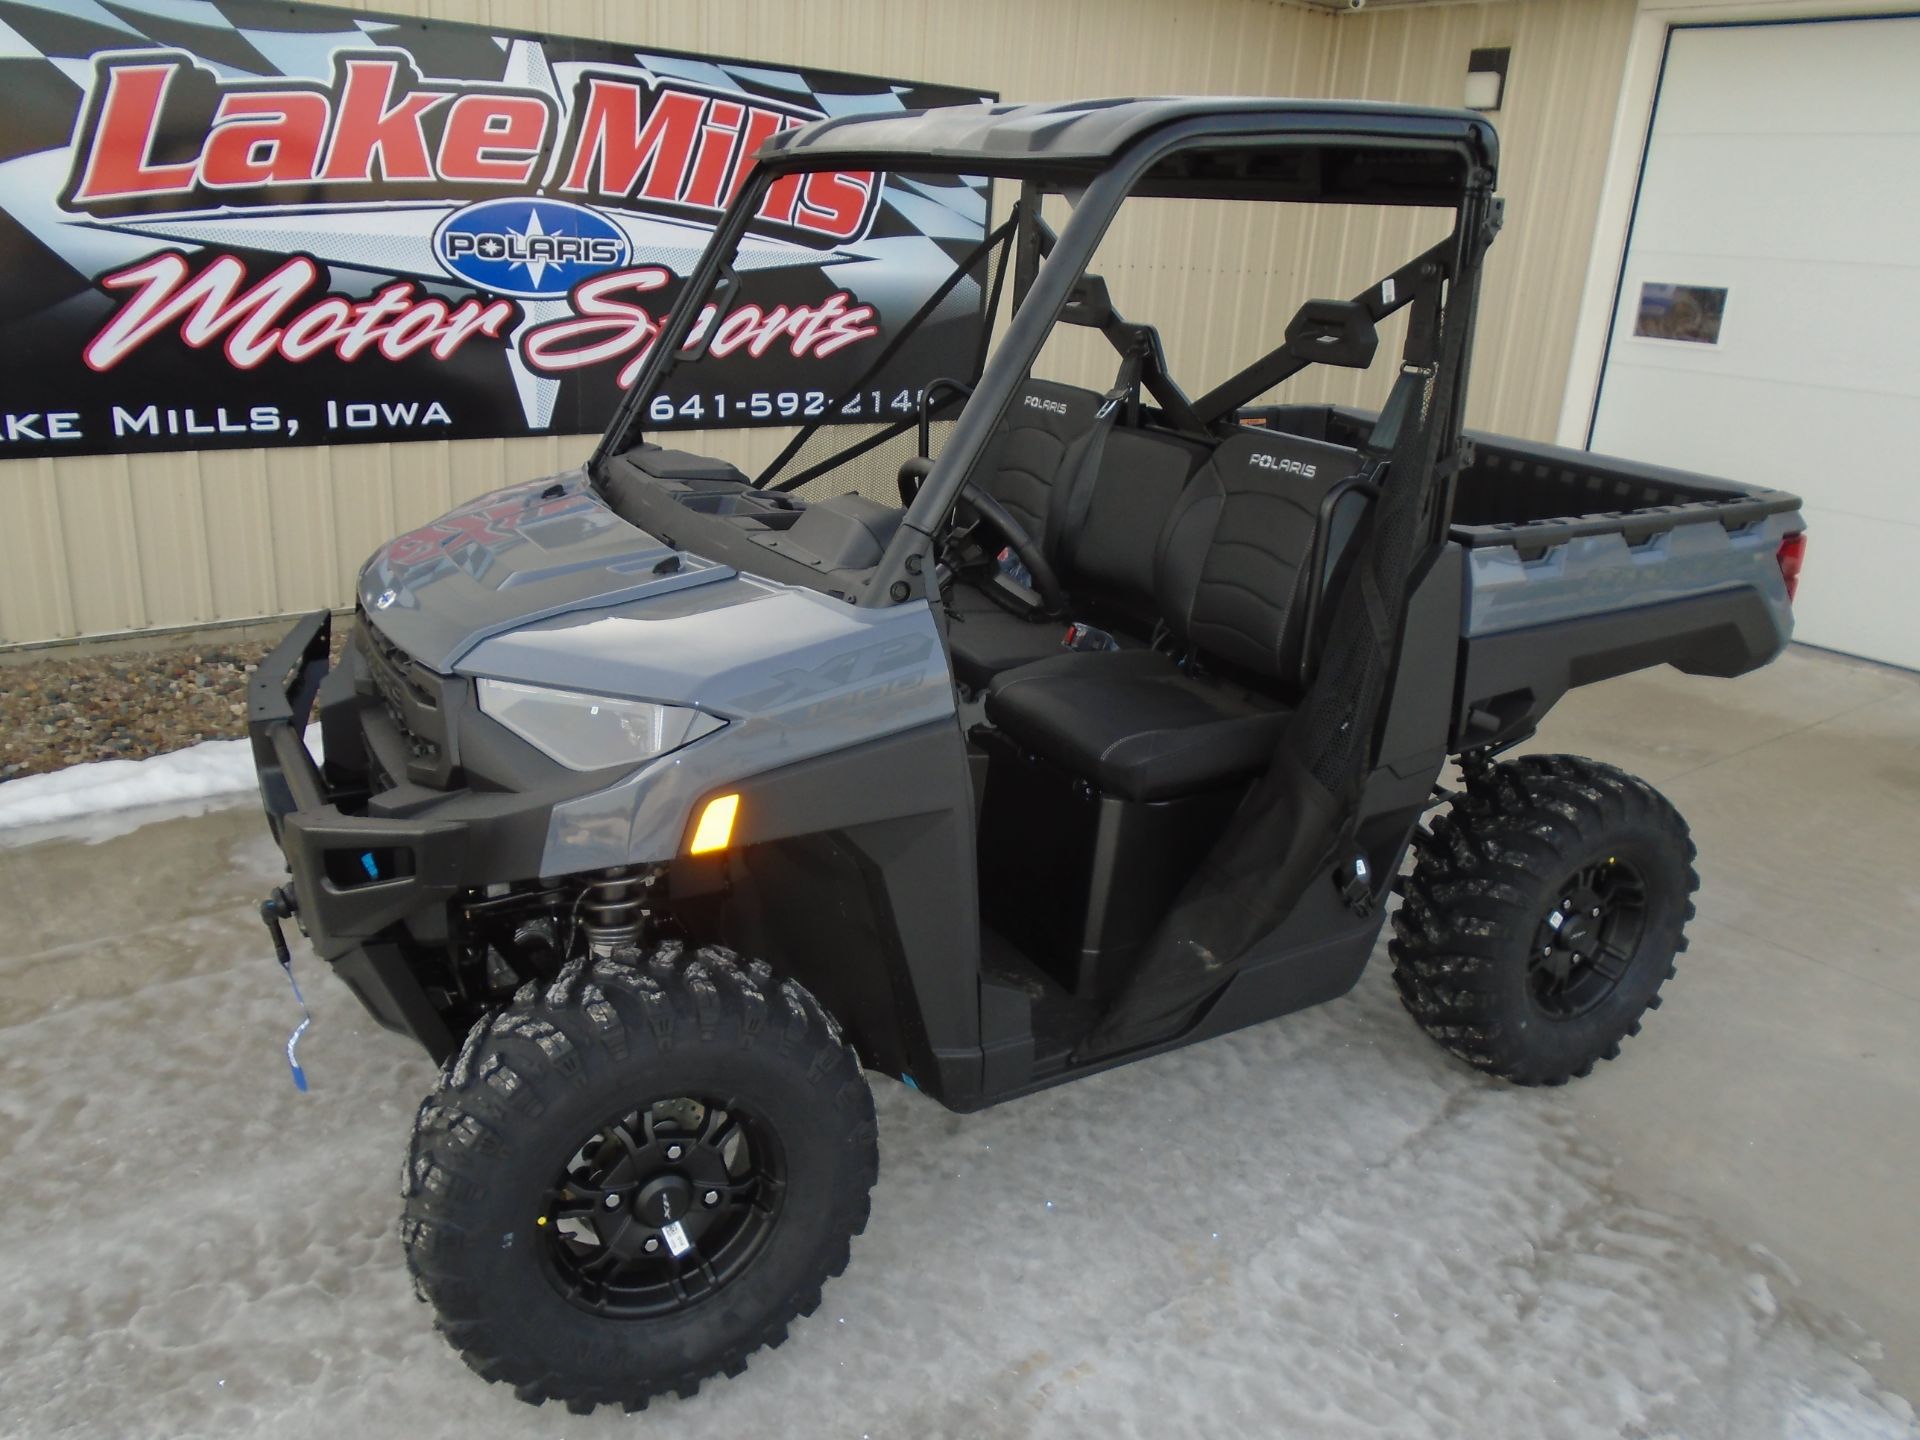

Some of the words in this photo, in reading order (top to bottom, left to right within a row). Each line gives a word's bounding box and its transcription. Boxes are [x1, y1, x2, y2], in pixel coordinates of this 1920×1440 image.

[74, 60, 549, 203] Lake
[445, 231, 619, 265] POLARIS
[83, 254, 515, 372] Motor
[0, 413, 83, 442] KE
[112, 405, 300, 437] MILLS,
[327, 400, 452, 429] IOWA
[1023, 394, 1068, 416] POLARIS
[1248, 452, 1318, 479] POLARIS
